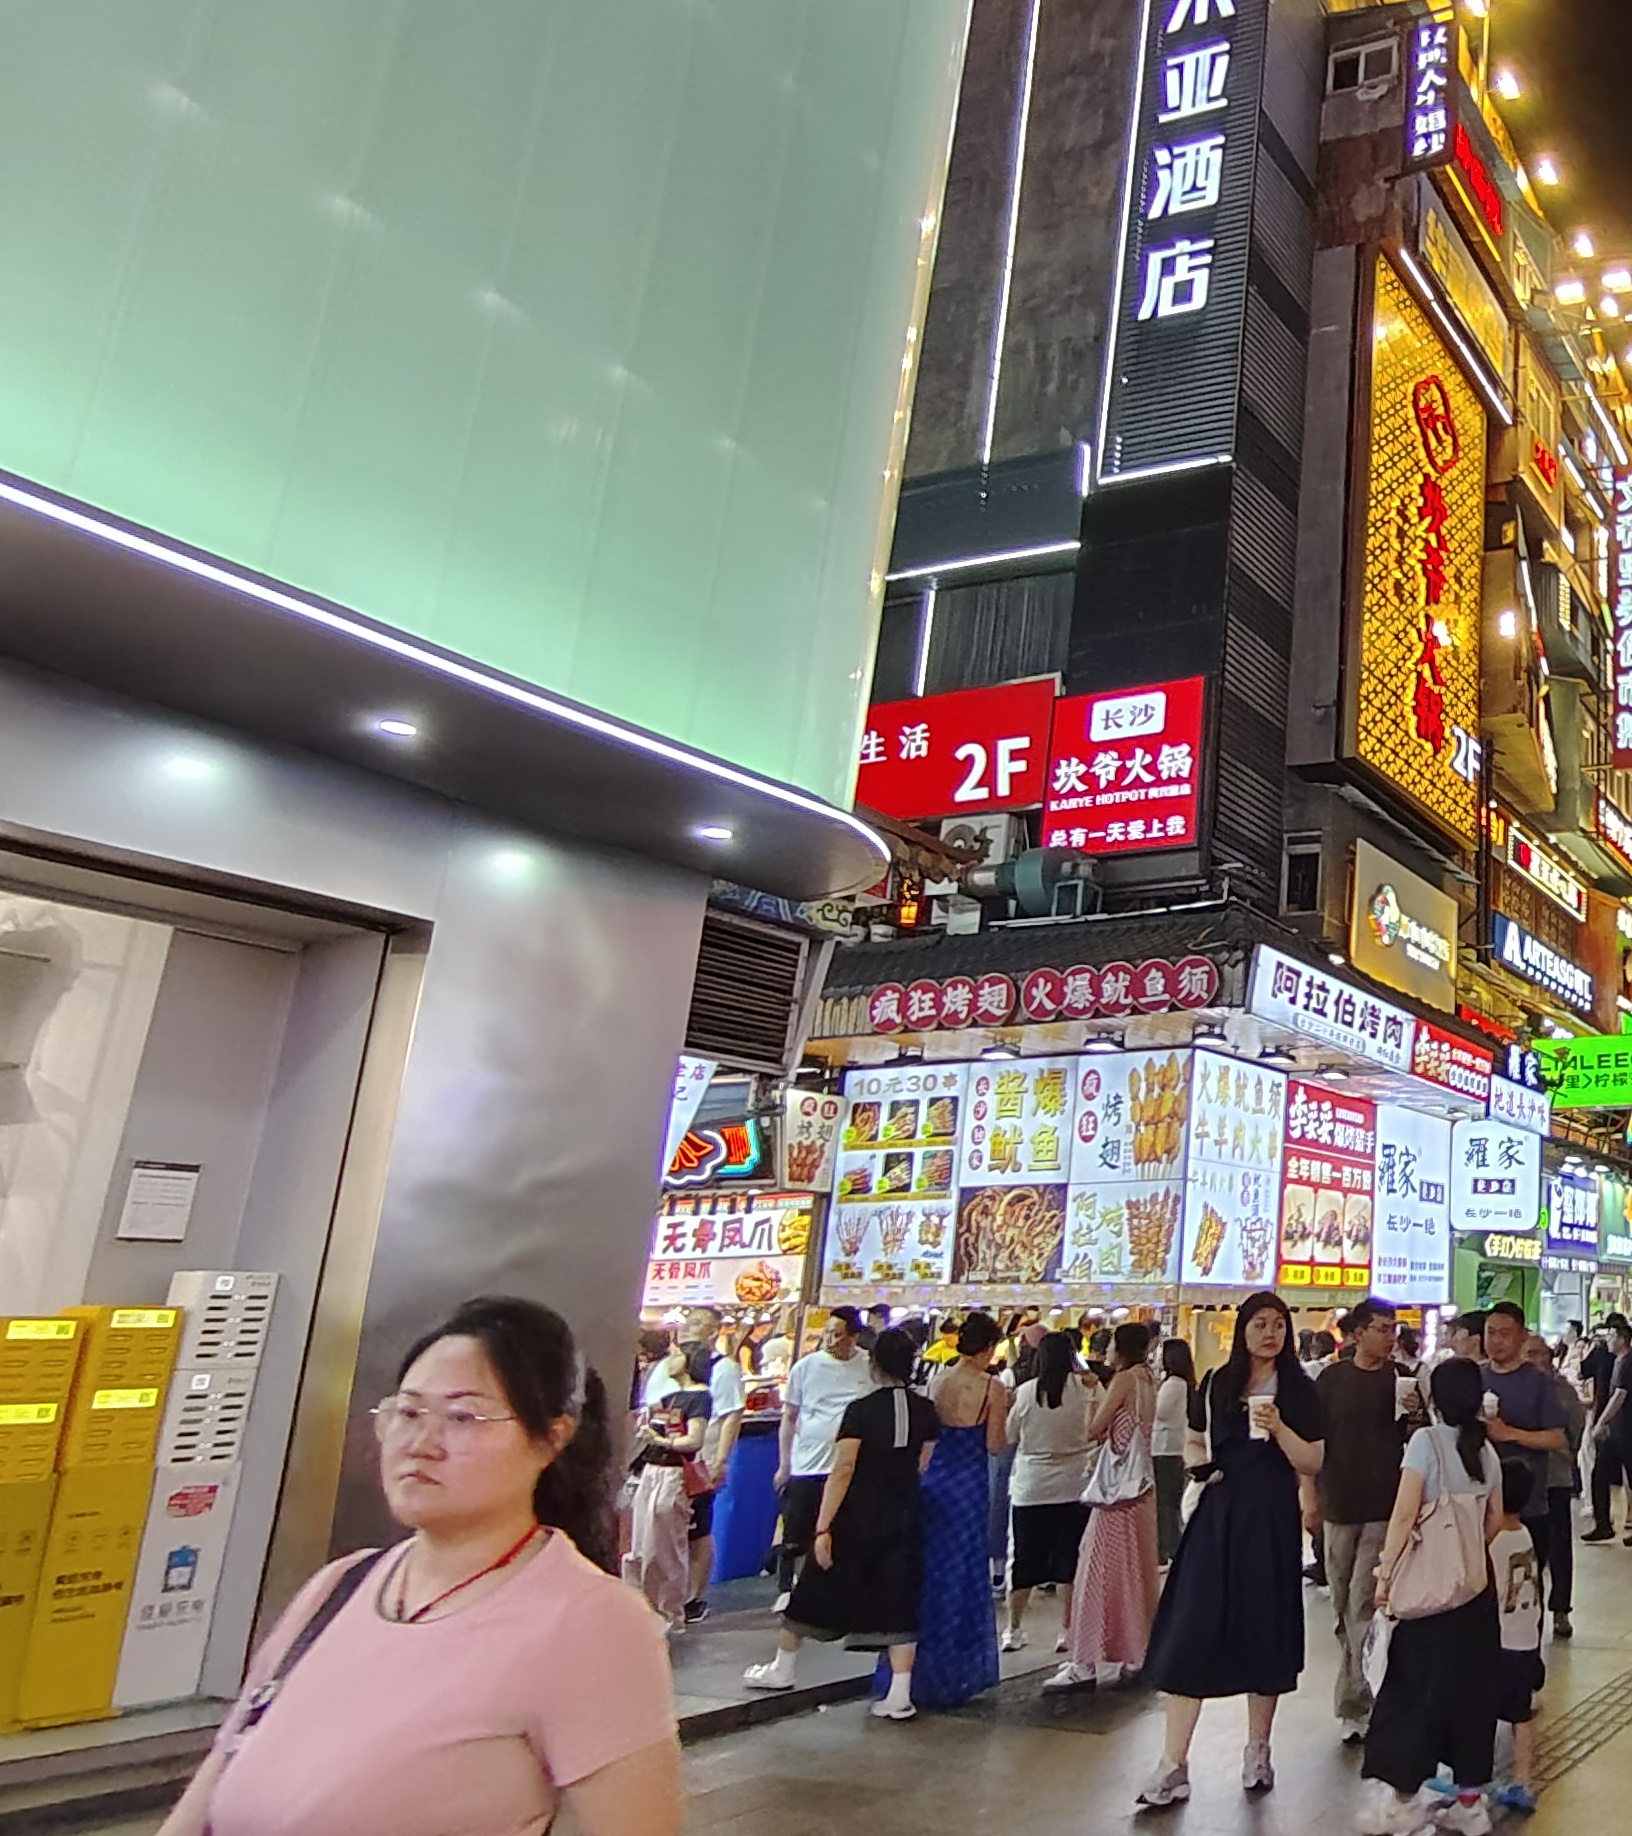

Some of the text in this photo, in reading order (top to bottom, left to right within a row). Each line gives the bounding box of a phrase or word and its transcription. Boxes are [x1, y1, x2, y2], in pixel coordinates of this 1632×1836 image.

[1101, 703, 1156, 731] 长沙
[859, 724, 931, 766] 生活
[1451, 725, 1482, 782] 2F
[954, 736, 1031, 803] 2F
[1052, 742, 1193, 794] 坎爷火锅
[1049, 795, 1094, 812] KANYE
[1095, 788, 1147, 807] HOTPOT
[1048, 815, 1187, 848] 总有一天爱上我
[872, 976, 1010, 1030] 疯狂烤翅
[1027, 959, 1216, 1018] 火爆鱿鱼须
[1271, 960, 1405, 1050] 阿拉伯烤肉
[853, 1072, 958, 1097] 10元30串
[1080, 1071, 1100, 1142] 疯狂
[797, 1121, 834, 1143] 烤翅
[988, 1123, 1061, 1175] 鱿鱼
[1098, 1092, 1125, 1171] 烤翅
[1286, 1156, 1373, 1191] 全年销售一百万份
[1464, 1136, 1526, 1170] 羅家
[661, 1216, 774, 1255] 无骨凤爪
[1067, 1190, 1099, 1282] 阿拉伯
[1386, 1213, 1437, 1236] 长沙一绝
[651, 1261, 712, 1280] 无骨凤爪
